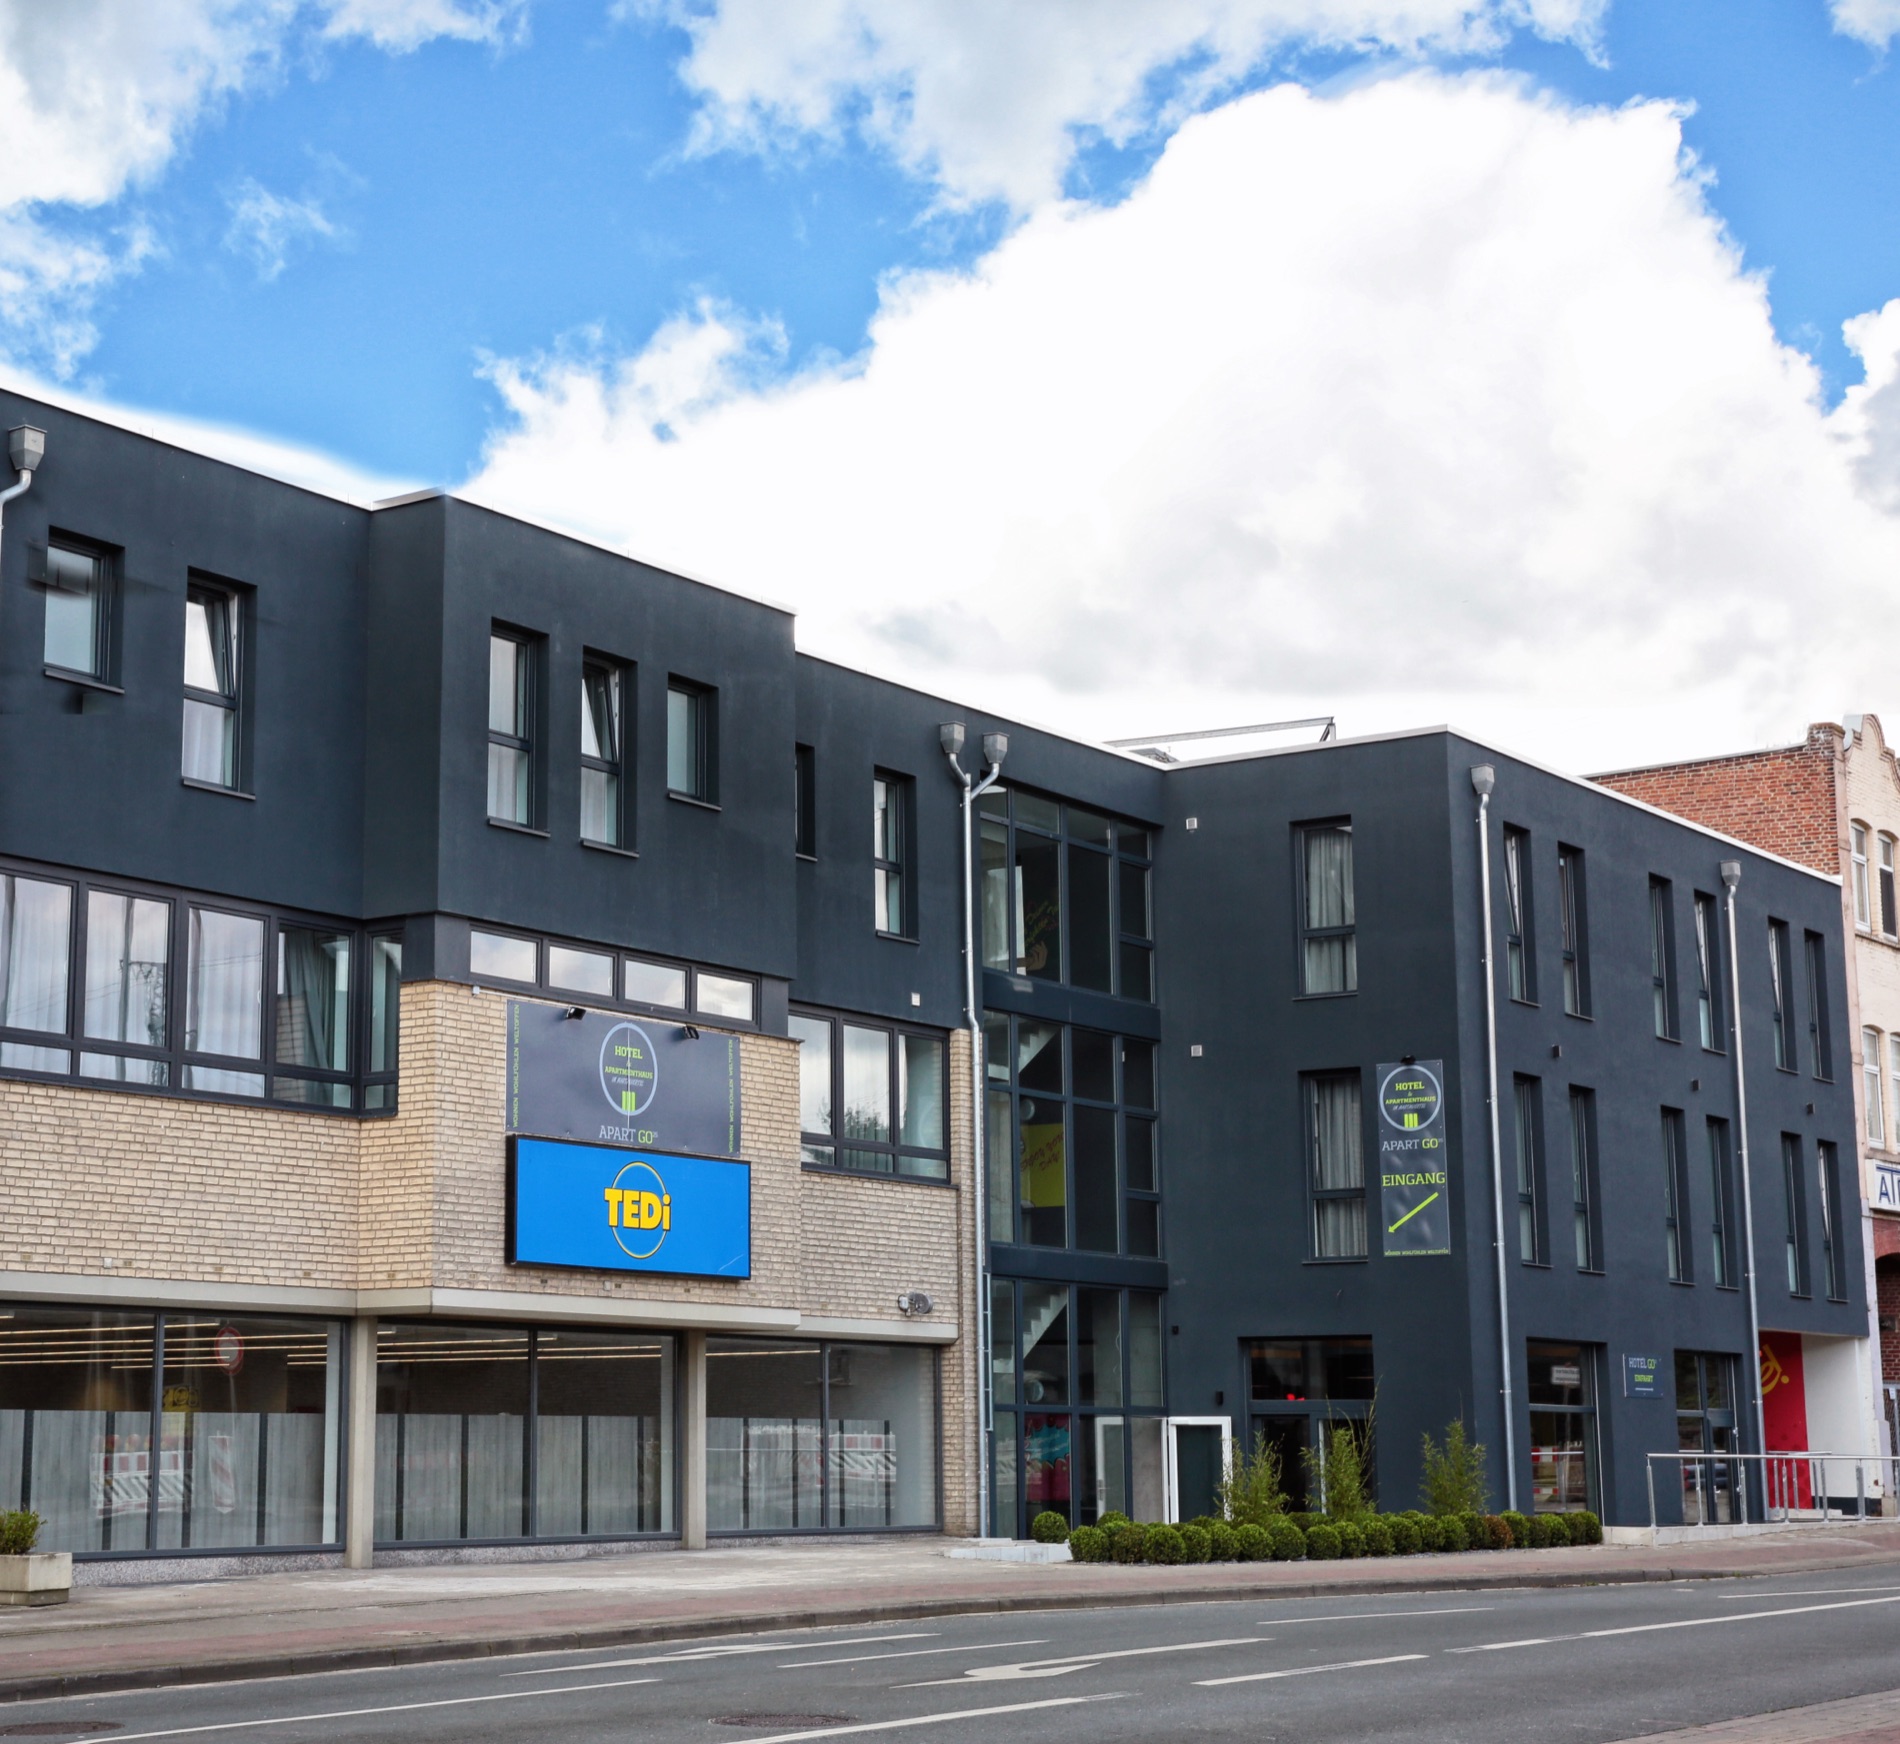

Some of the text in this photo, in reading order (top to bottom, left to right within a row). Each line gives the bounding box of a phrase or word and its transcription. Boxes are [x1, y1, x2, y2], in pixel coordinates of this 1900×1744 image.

[614, 1045, 643, 1060] HOTEL
[1395, 1081, 1425, 1091] HOTEL
[1385, 1096, 1437, 1105] APARTMENTHAUS
[599, 1125, 636, 1142] APART
[1382, 1139, 1420, 1152] APART
[1382, 1171, 1446, 1187] EINGANG
[604, 1187, 671, 1231] TEDi
[1628, 1357, 1647, 1369] HOTEL
